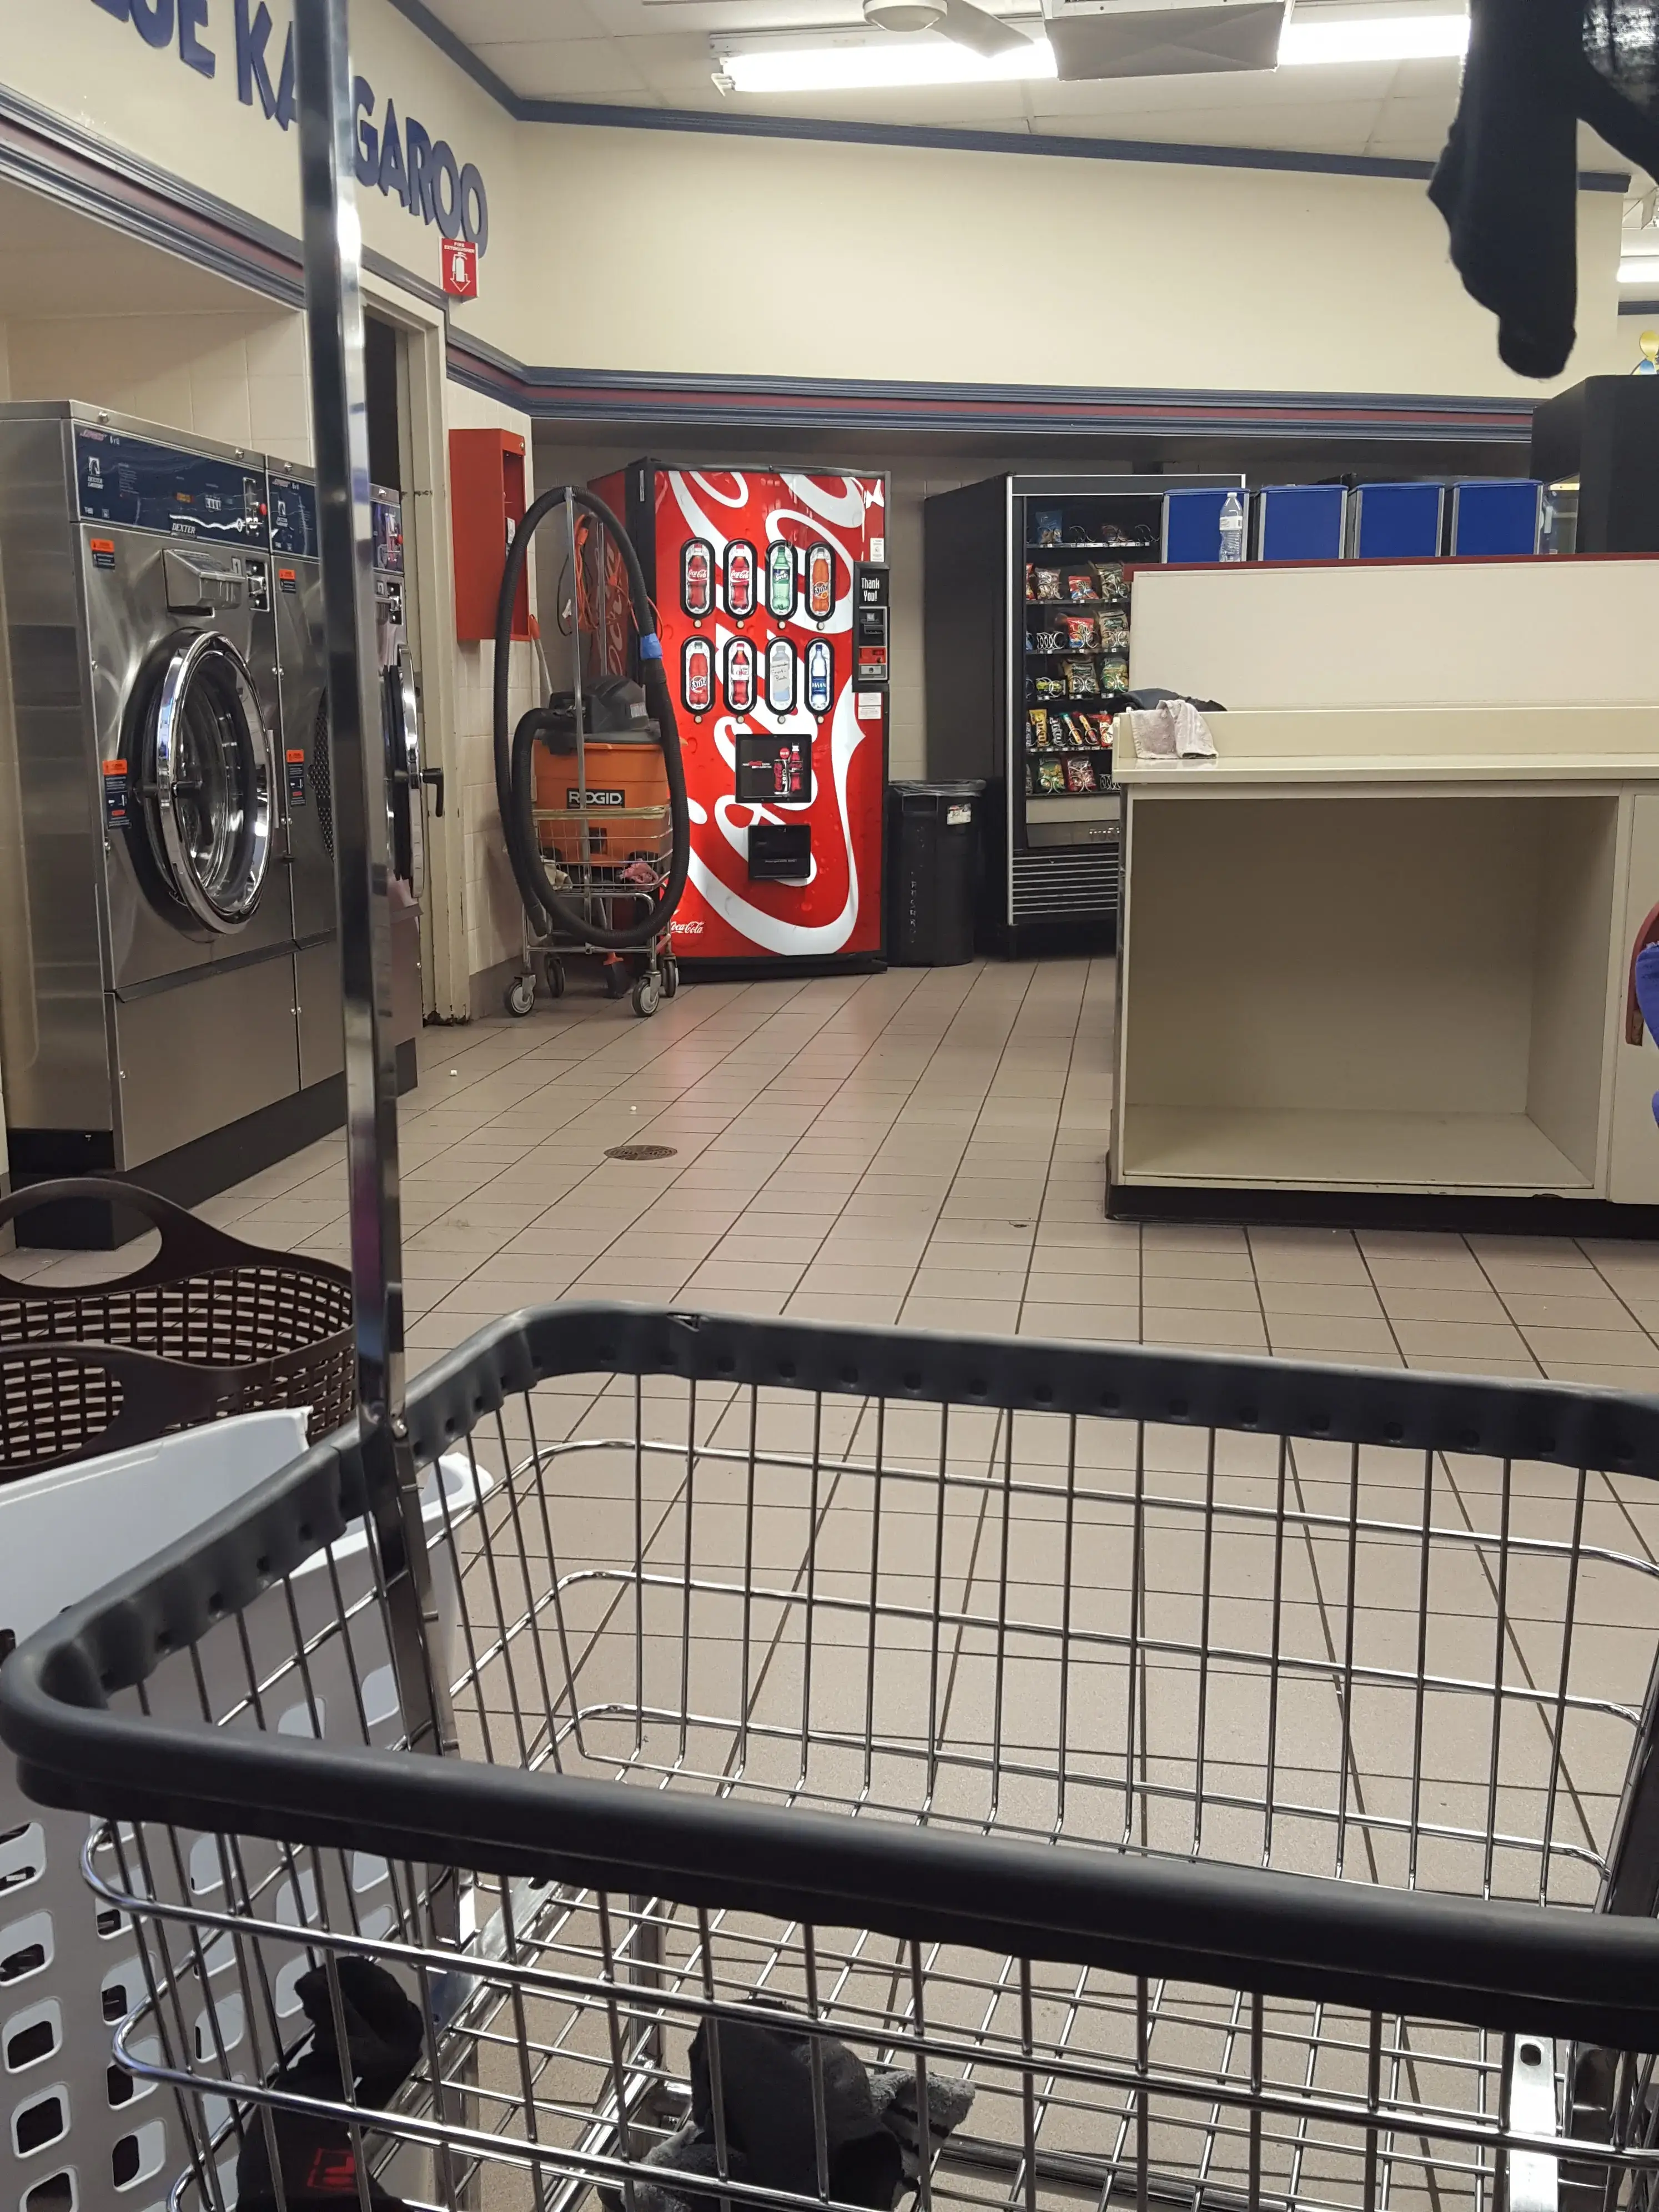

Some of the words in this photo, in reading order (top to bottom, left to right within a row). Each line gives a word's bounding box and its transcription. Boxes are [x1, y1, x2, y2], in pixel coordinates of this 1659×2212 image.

[234, 0, 487, 259] KAGAROO
[172, 522, 195, 534] DEXTER
[688, 569, 707, 578] Coca-Cola
[731, 570, 750, 579] Coca-Cola
[861, 577, 879, 589] Thank
[863, 590, 877, 602] You!
[569, 791, 622, 805] RDGID
[671, 921, 705, 934] Coca-Cola
